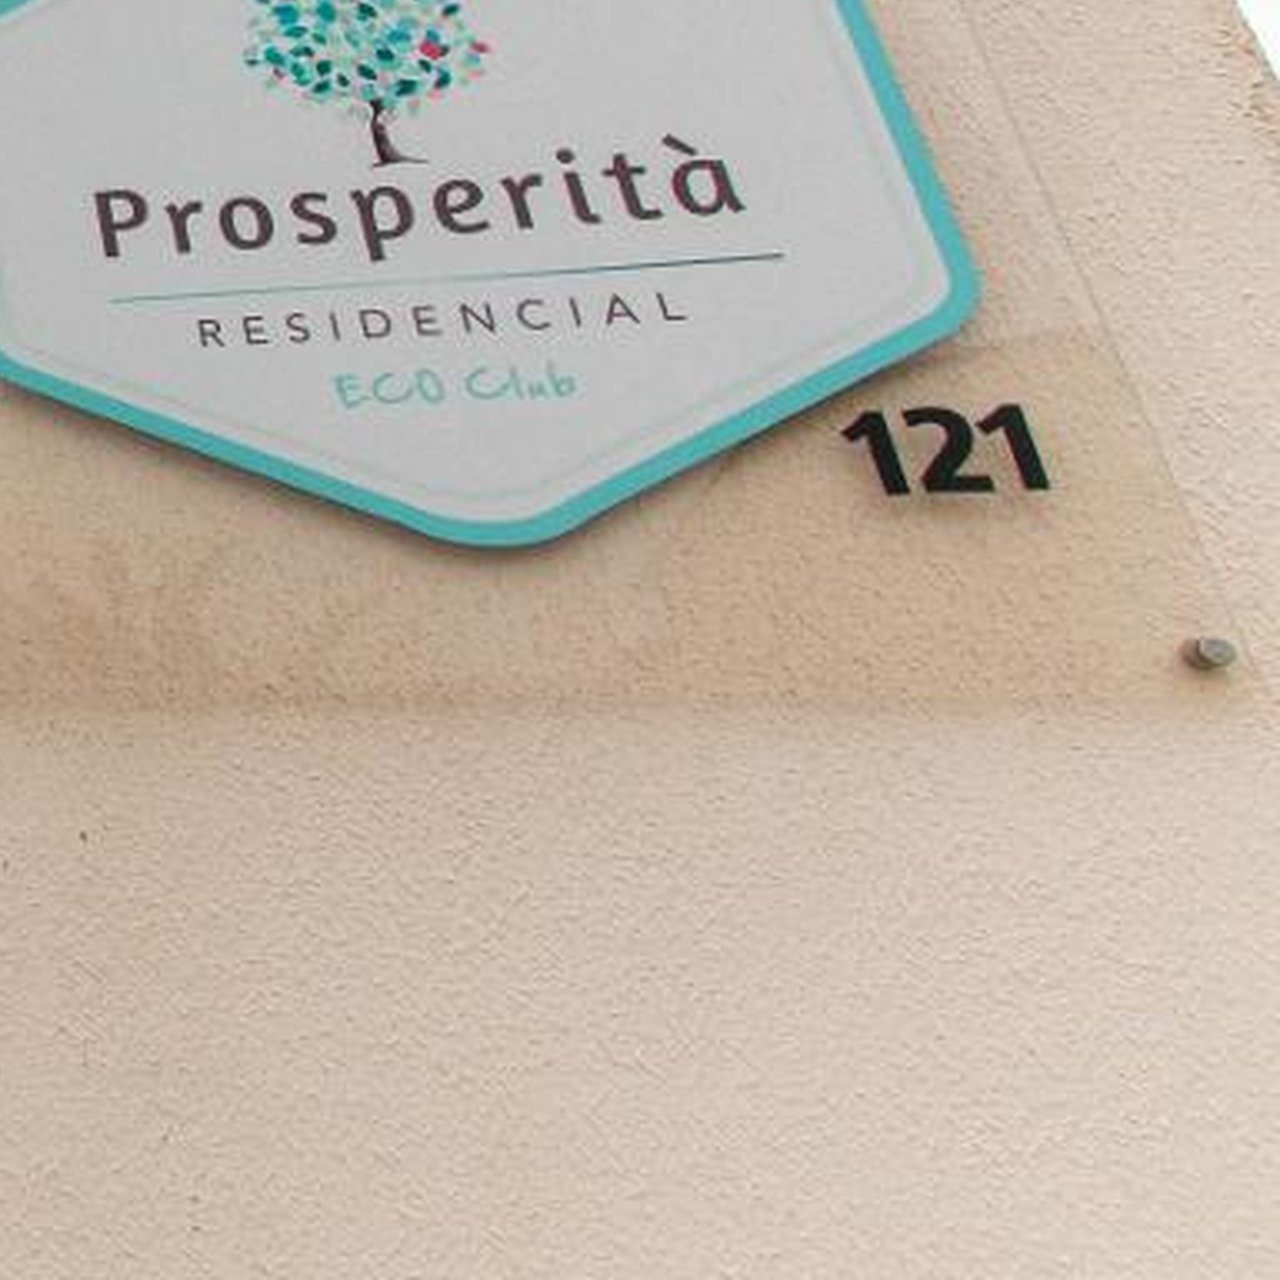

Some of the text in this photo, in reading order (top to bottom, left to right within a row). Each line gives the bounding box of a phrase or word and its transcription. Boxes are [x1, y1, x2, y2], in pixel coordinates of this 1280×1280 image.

[93, 133, 746, 262] Prosperità
[197, 291, 689, 349] RESIDENCIAL
[332, 361, 578, 410] ECO Club
[841, 403, 1051, 497] 121
